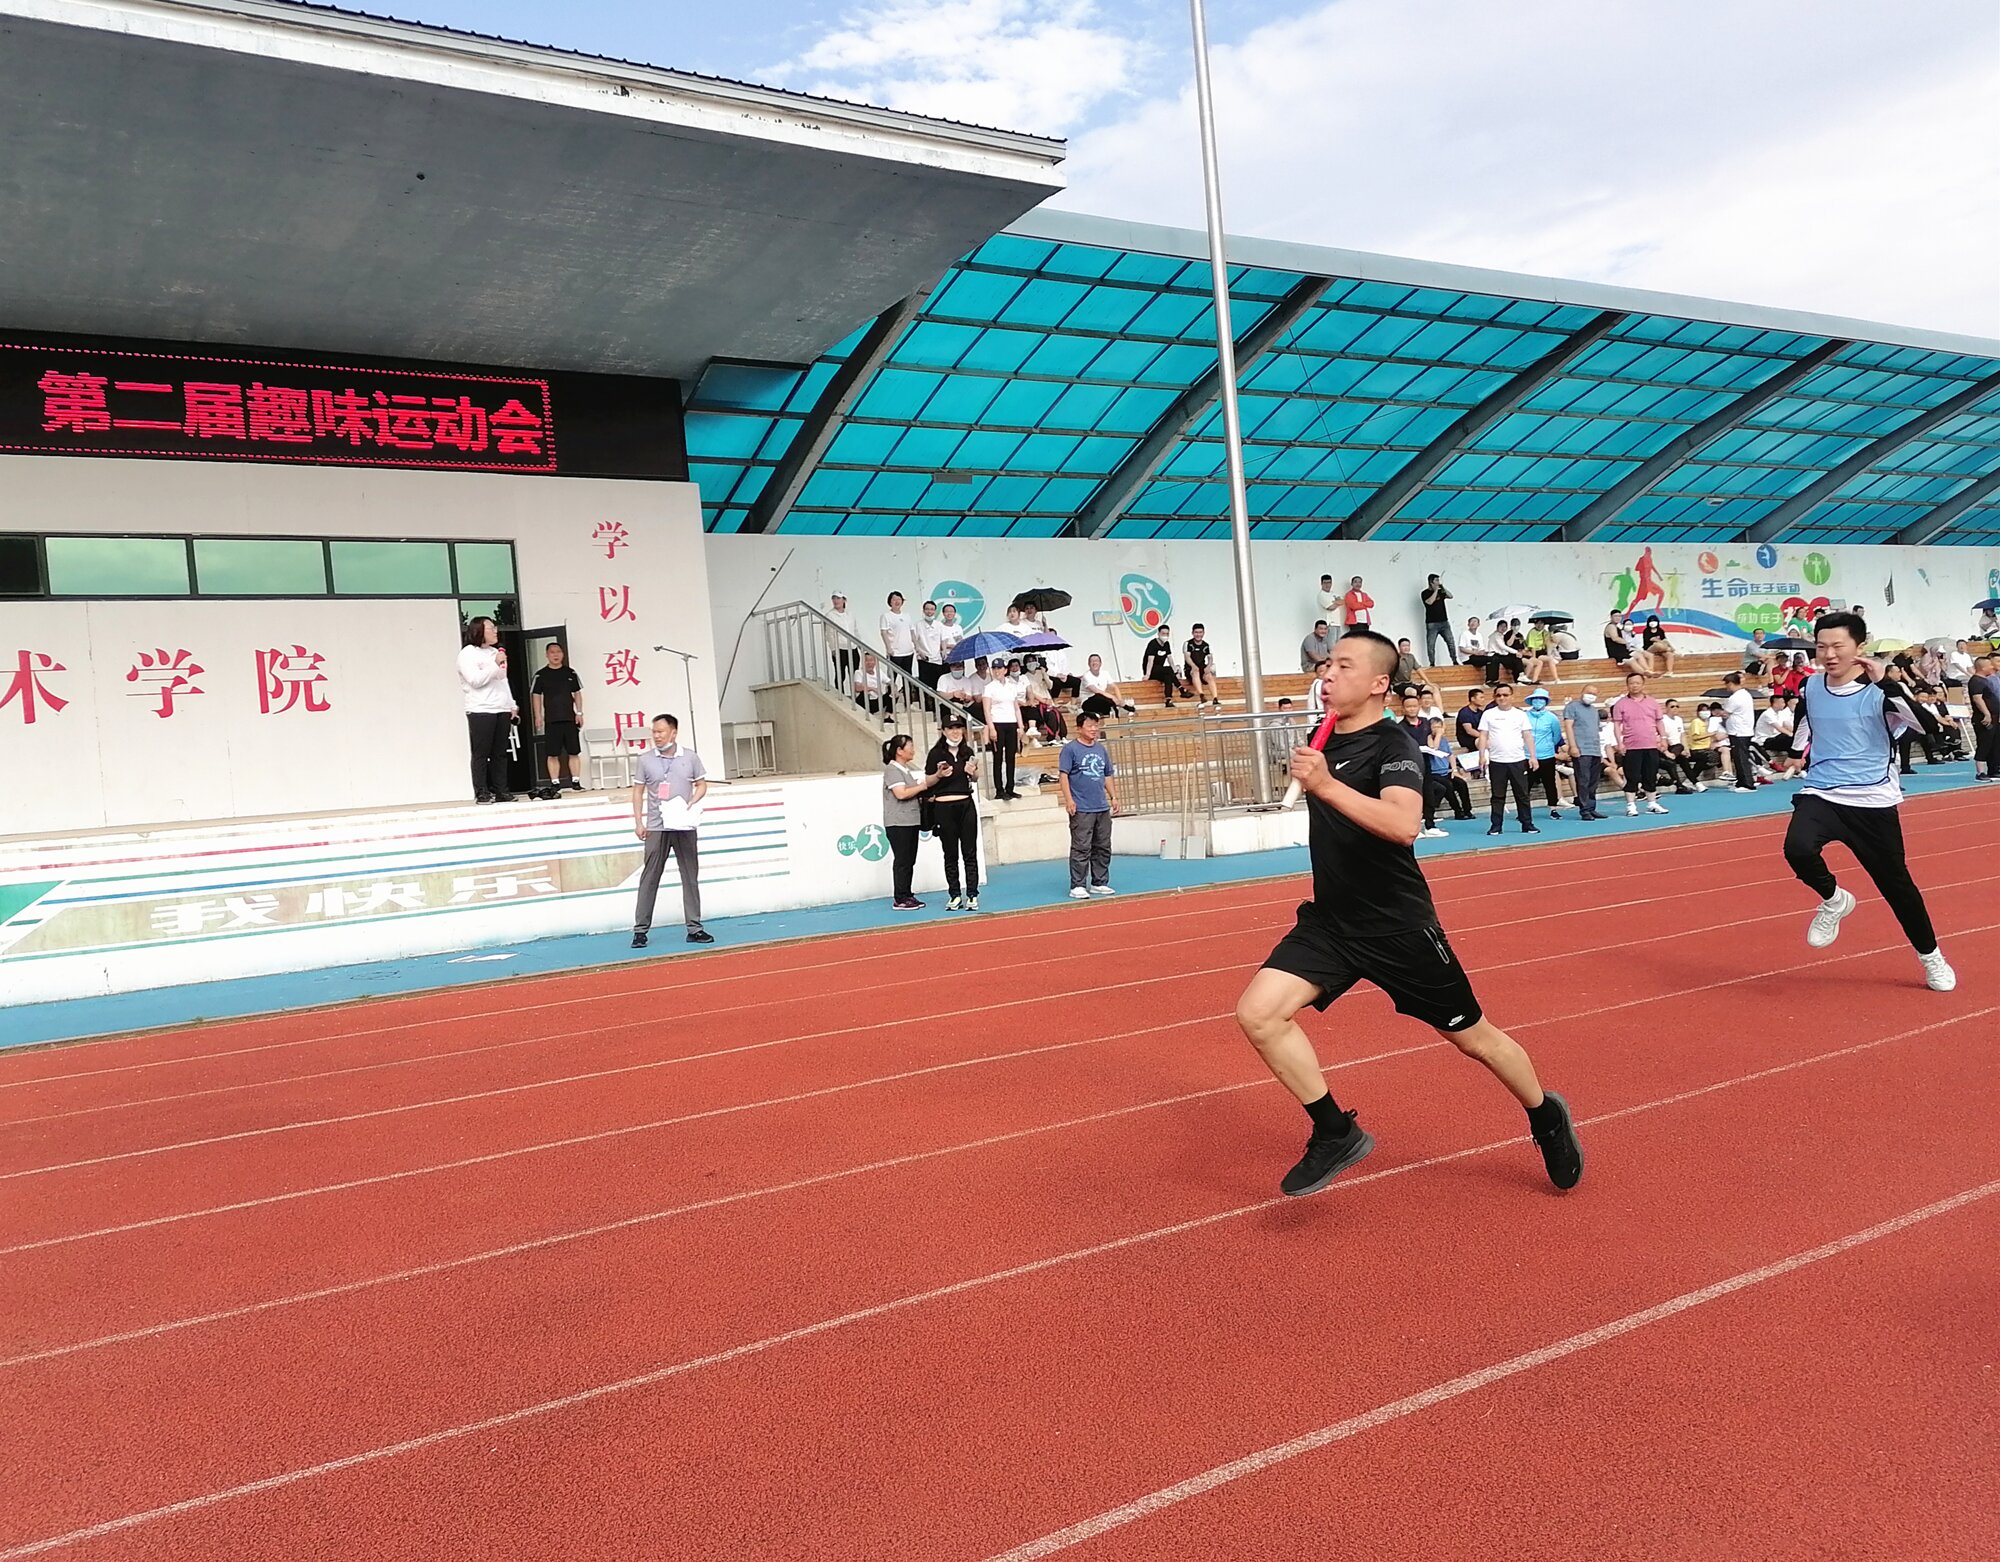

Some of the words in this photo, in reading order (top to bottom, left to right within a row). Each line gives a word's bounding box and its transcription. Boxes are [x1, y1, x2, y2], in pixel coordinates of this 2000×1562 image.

[37, 370, 544, 454] 第二届趣味运动会
[1701, 577, 1801, 598] 生命在于运动
[592, 520, 648, 750] 学以致用
[150, 865, 558, 935] 我快乐
